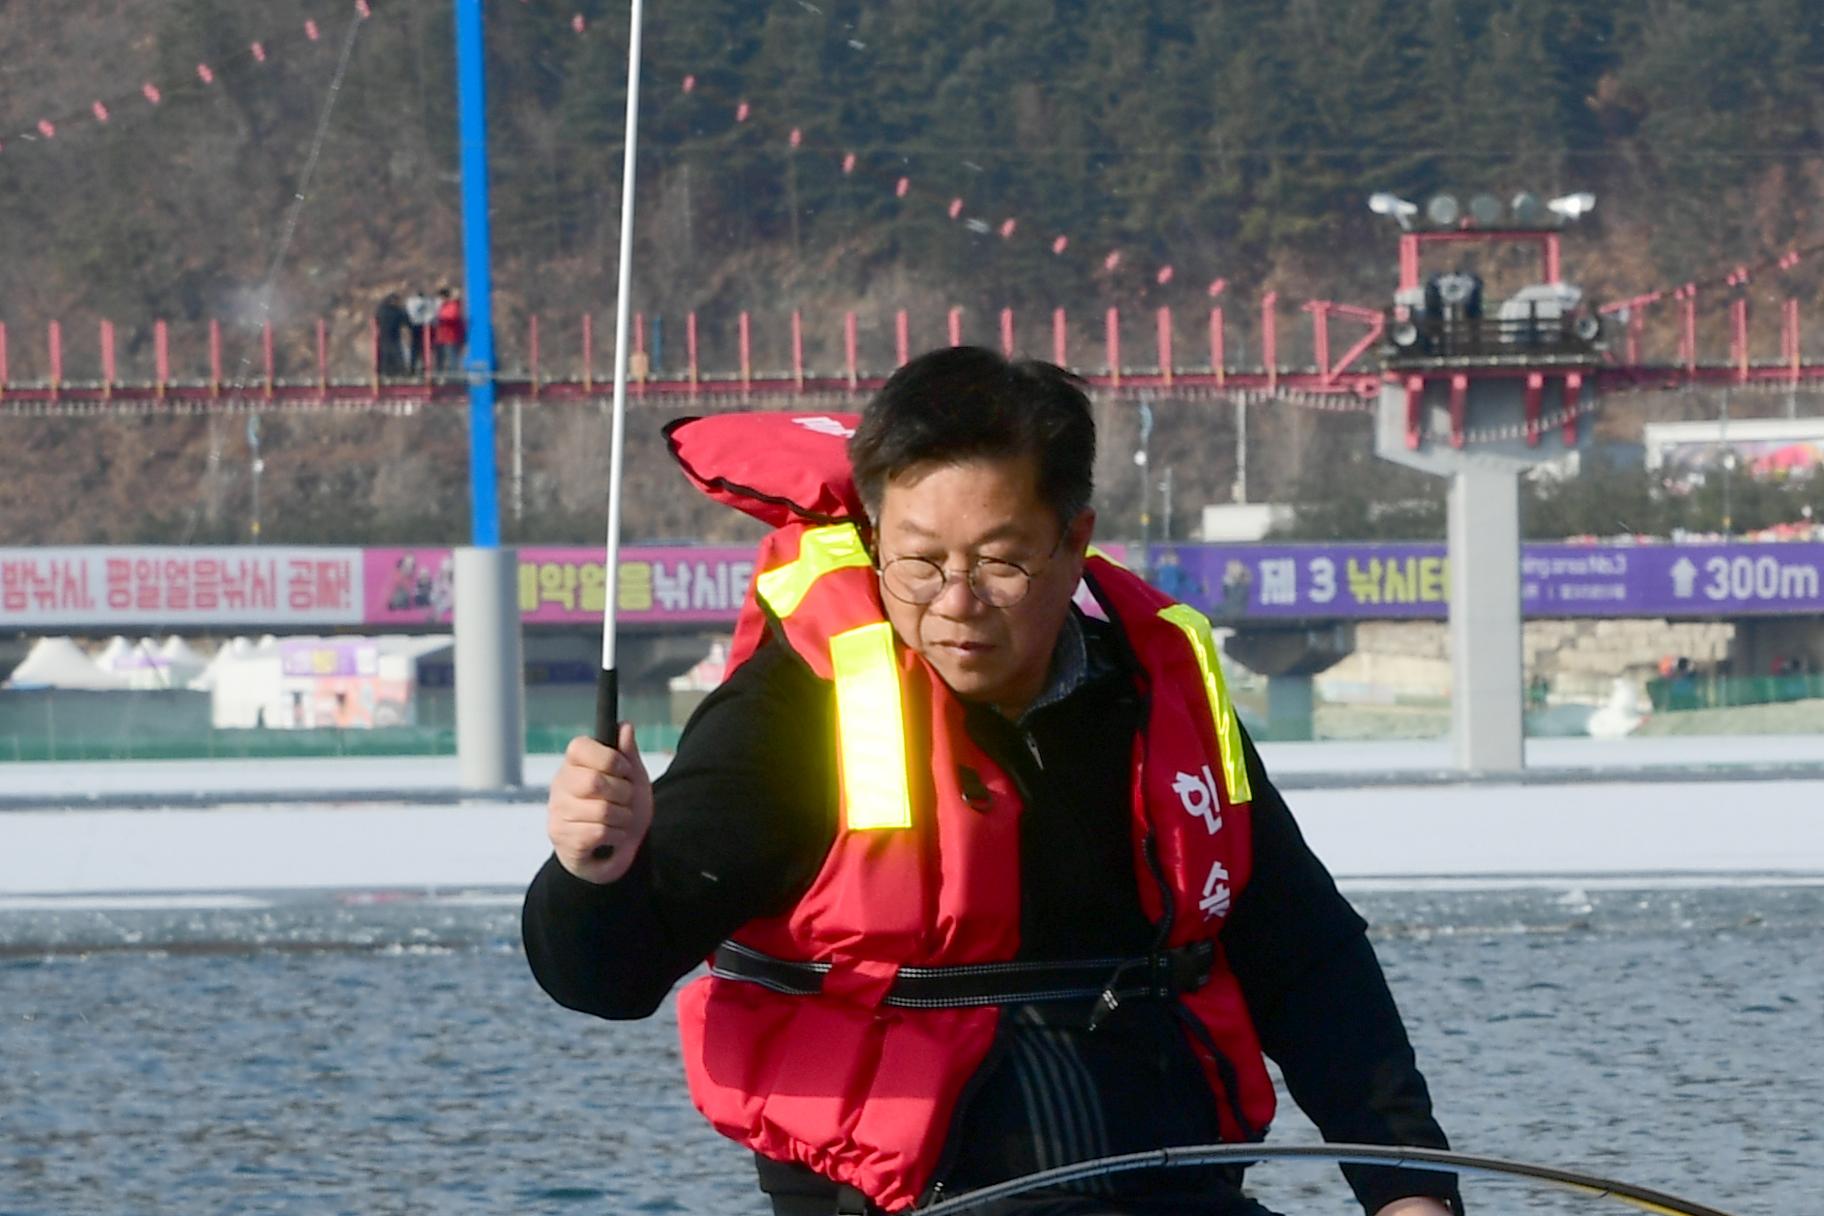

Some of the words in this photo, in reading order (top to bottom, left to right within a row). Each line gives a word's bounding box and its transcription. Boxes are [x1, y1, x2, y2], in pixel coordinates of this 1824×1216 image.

[106, 558, 276, 610] 평일얼음낚시
[1258, 557, 1297, 605] 제
[1308, 556, 1336, 603] 3
[1704, 556, 1819, 600] 300m
